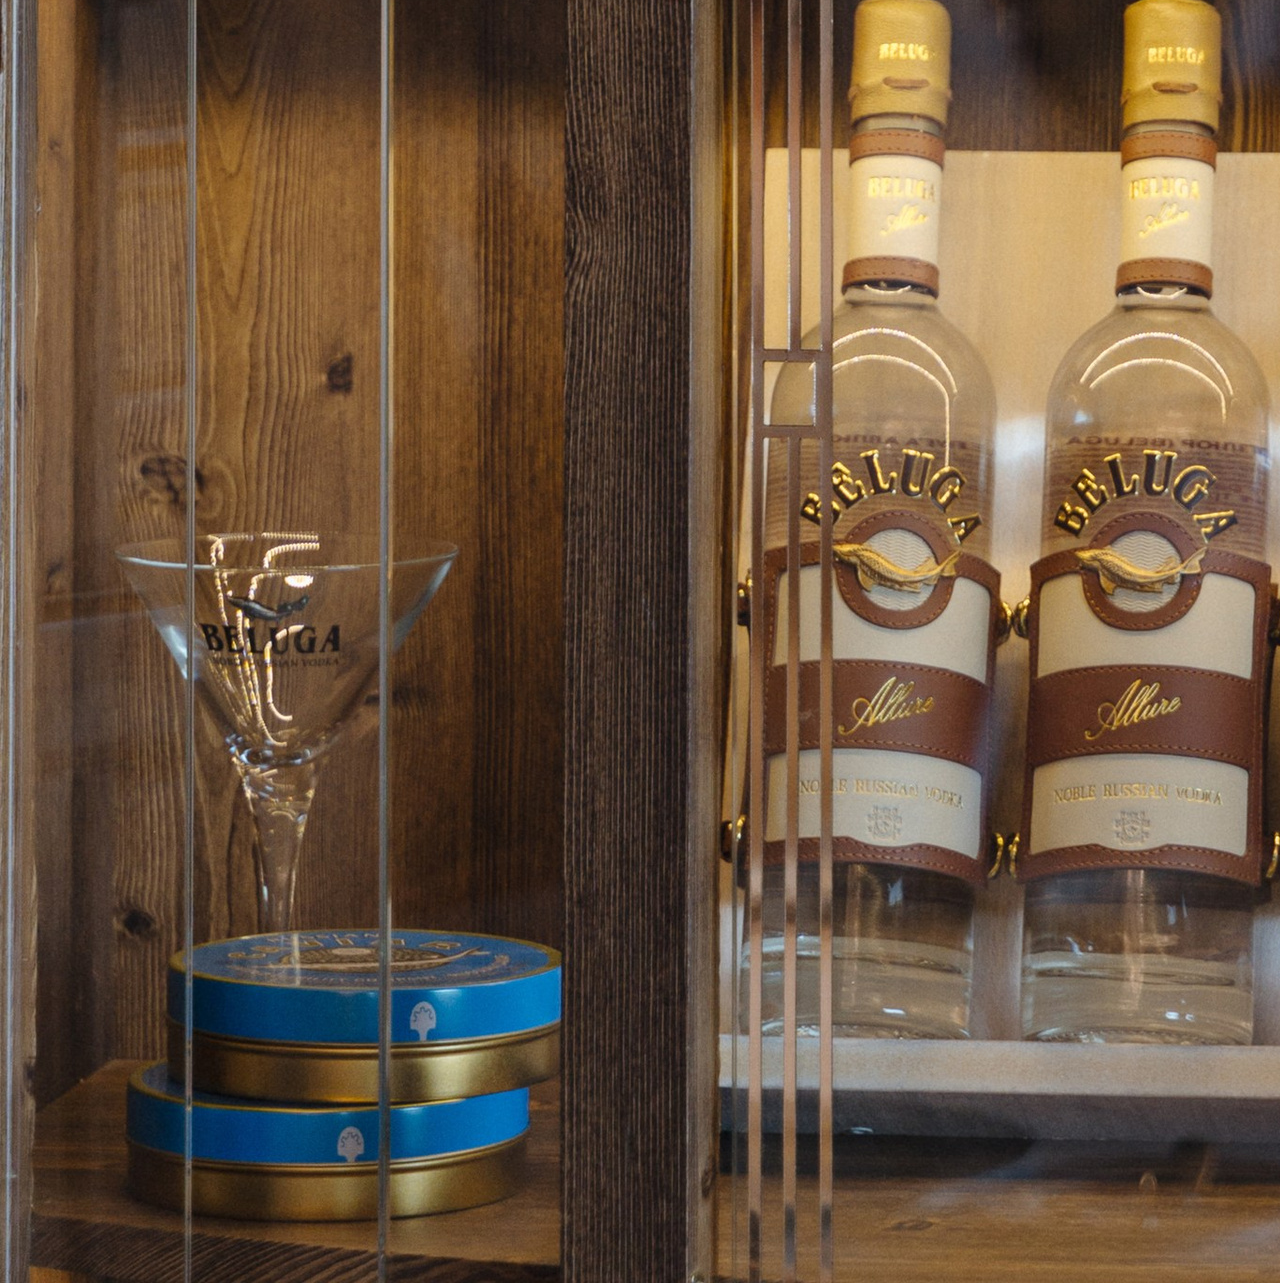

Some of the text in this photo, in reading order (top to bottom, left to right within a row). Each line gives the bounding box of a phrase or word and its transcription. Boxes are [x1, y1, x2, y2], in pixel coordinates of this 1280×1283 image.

[1148, 46, 1205, 64] BELUGA
[868, 176, 936, 202] BELUGA
[1130, 176, 1199, 200] BELUGA
[801, 448, 983, 545] BELUGA
[1054, 449, 1239, 545] BELUGA
[200, 623, 341, 654] BELUGA
[838, 676, 934, 736] Allure
[1085, 678, 1181, 740] Allure
[853, 778, 918, 797] RUSSIAN
[925, 786, 964, 809] VODKA
[1053, 784, 1223, 806] NOBLE RUSSIAN VODKA
